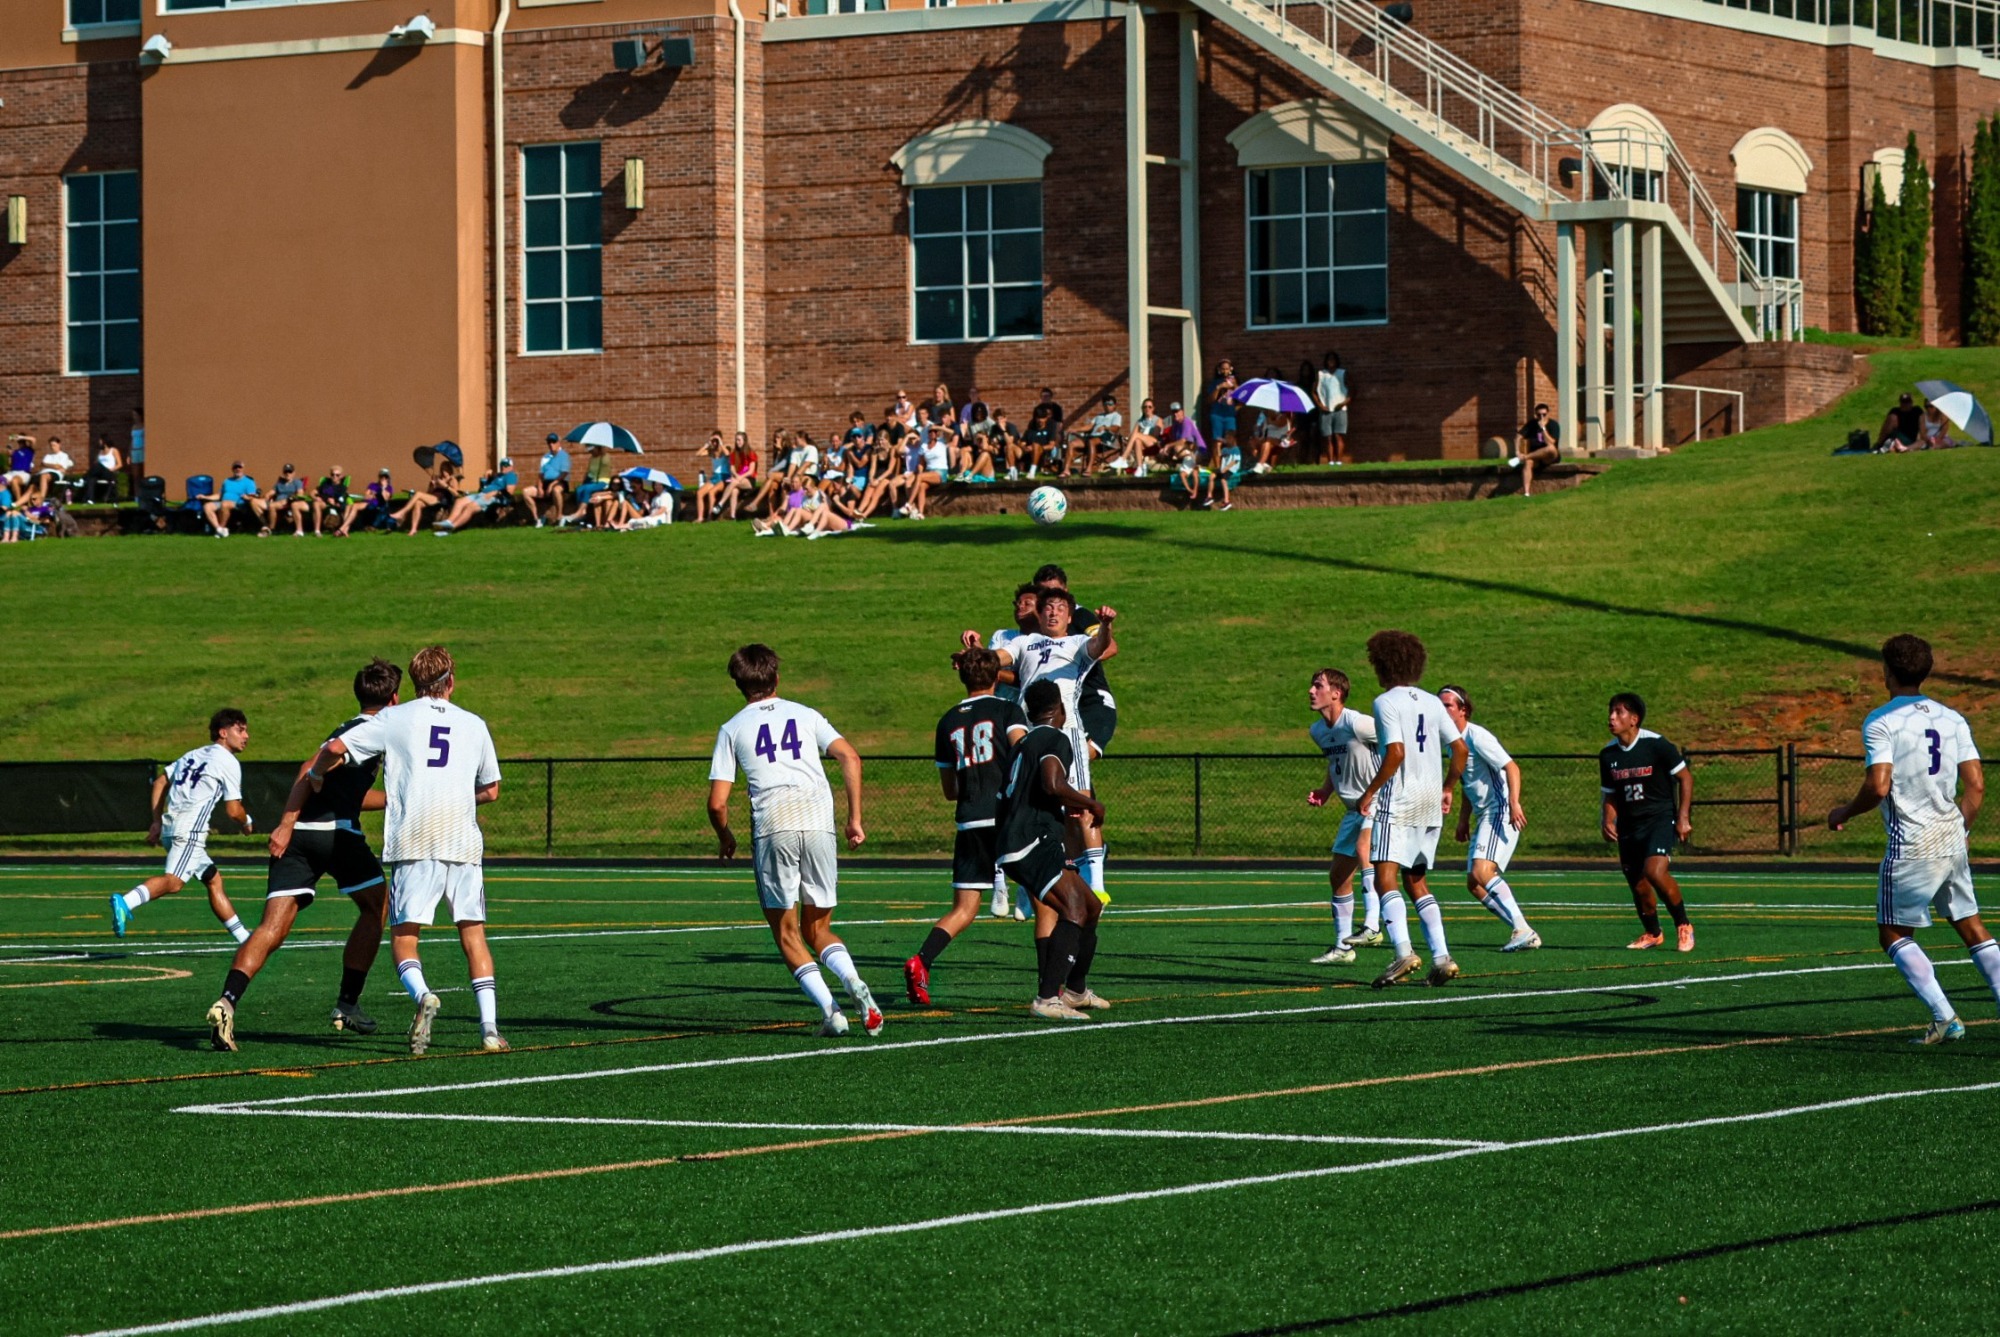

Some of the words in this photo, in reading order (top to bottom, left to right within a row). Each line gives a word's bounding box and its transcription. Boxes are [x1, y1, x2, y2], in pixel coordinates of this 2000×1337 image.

[427, 725, 451, 768] 5
[755, 718, 803, 763] 44
[949, 719, 996, 770] 18
[1416, 713, 1427, 752] 4
[1925, 728, 1941, 775] 3
[175, 758, 208, 789] 34
[1624, 783, 1645, 802] 22
